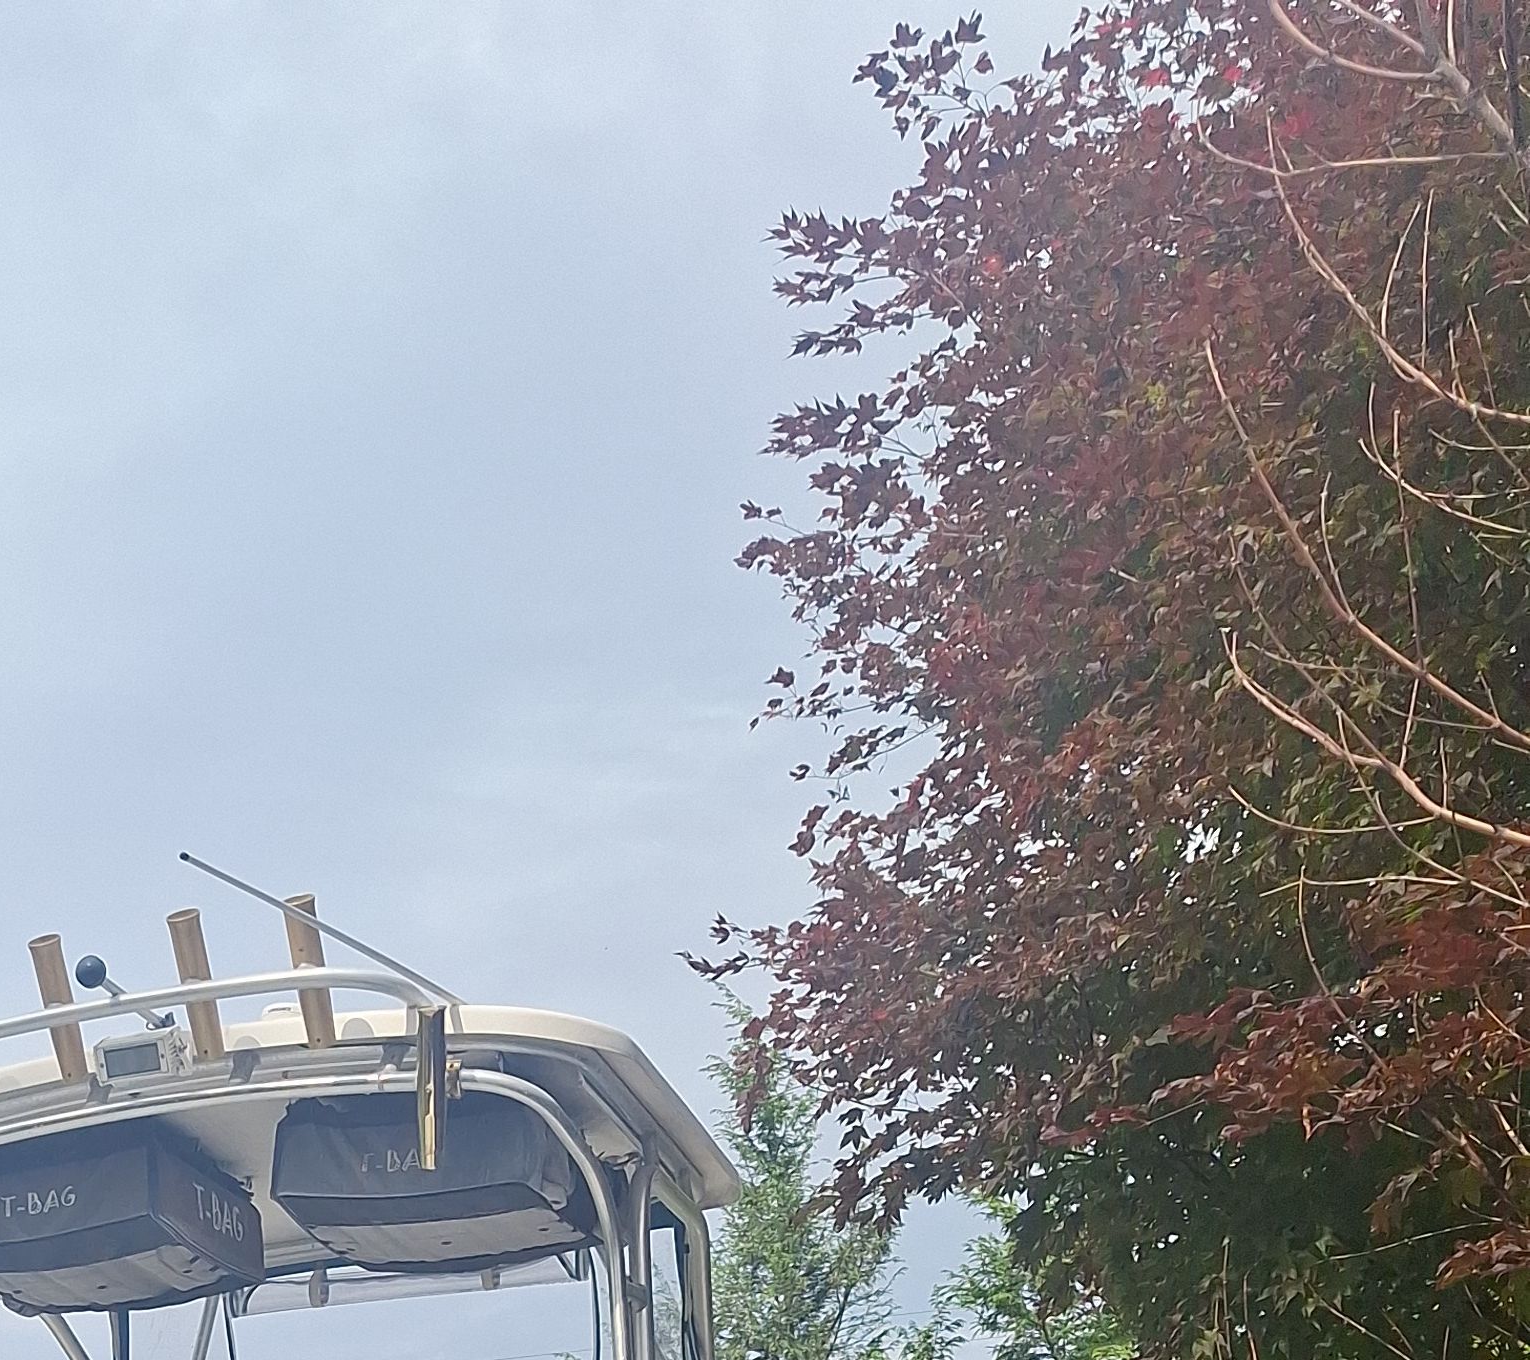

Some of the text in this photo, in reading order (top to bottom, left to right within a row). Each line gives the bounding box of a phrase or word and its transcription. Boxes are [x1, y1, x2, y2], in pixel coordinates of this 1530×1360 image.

[360, 1147, 421, 1173] T-BA
[0, 1185, 78, 1218] T-BAG
[191, 1180, 245, 1243] T-BAG
